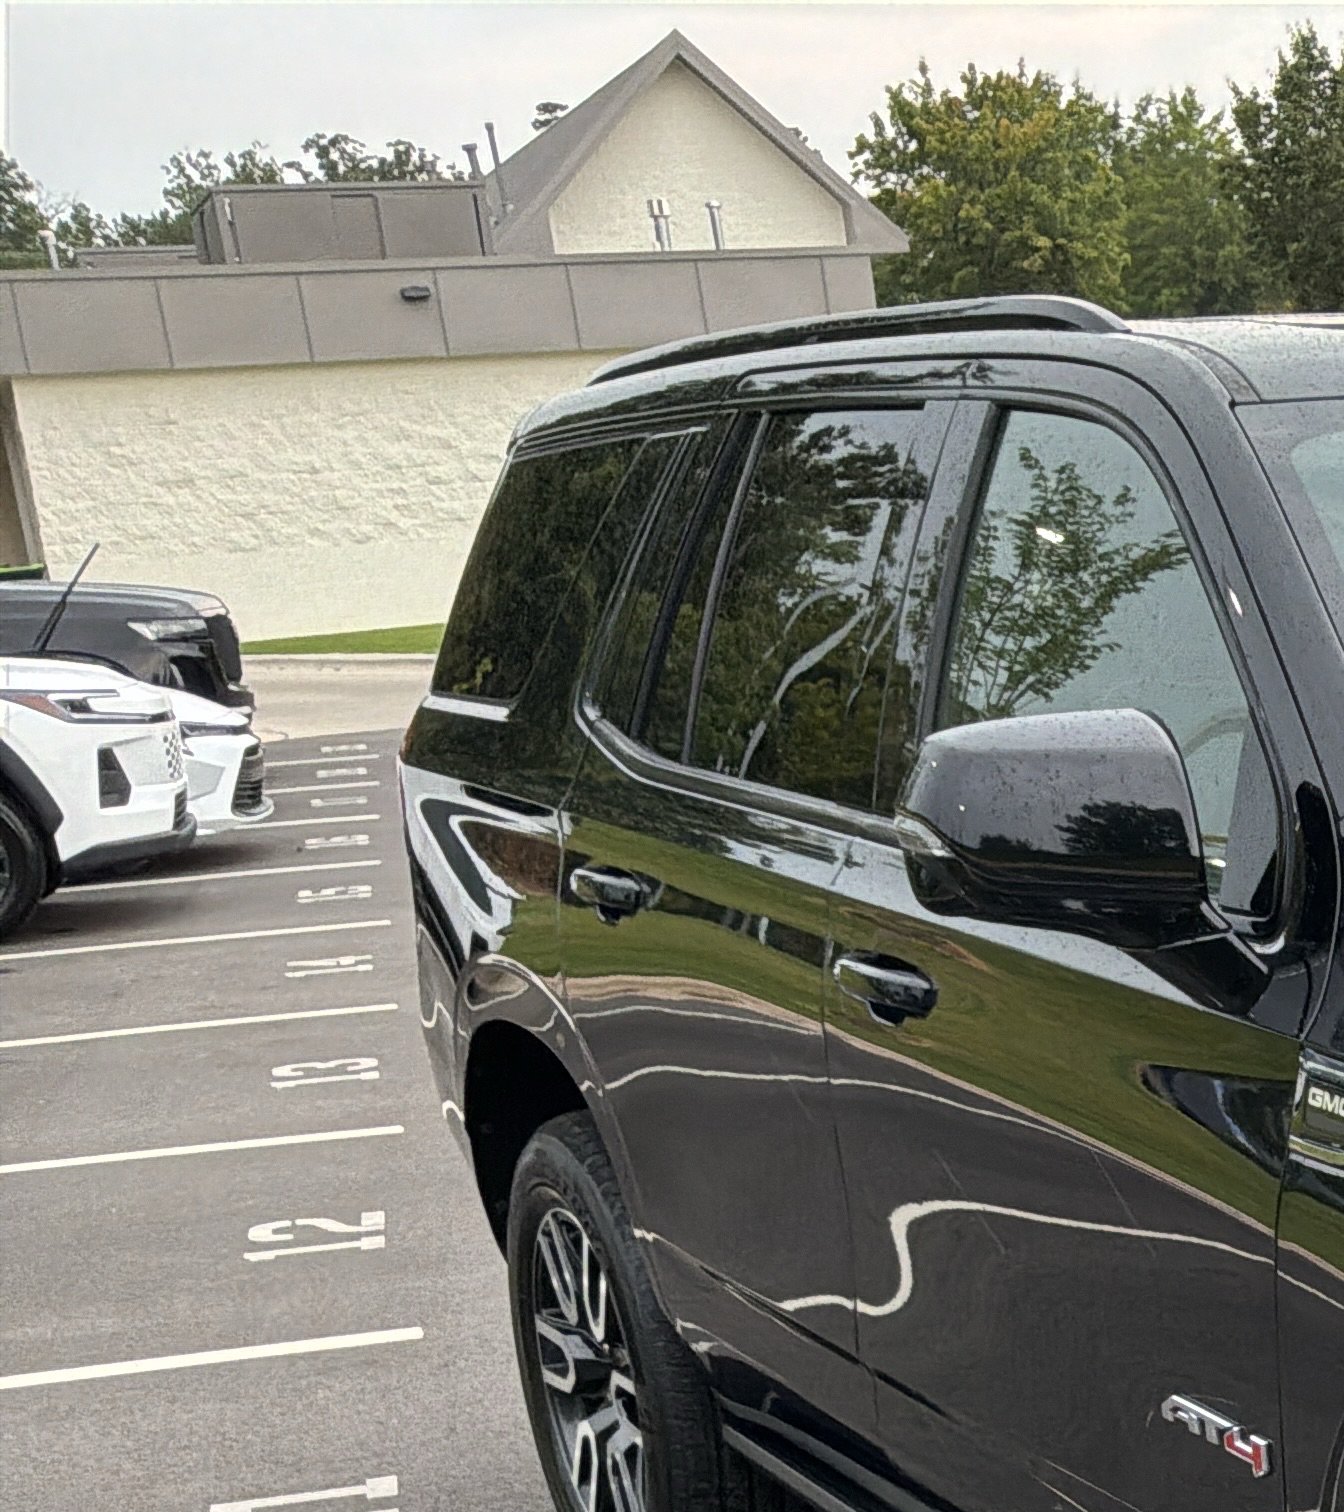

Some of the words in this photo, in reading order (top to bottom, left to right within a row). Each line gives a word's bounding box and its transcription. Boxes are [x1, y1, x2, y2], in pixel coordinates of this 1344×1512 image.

[284, 954, 373, 977] 14
[270, 1057, 380, 1089] 13
[243, 1210, 385, 1262] 12
[1161, 1394, 1270, 1478] AT4
